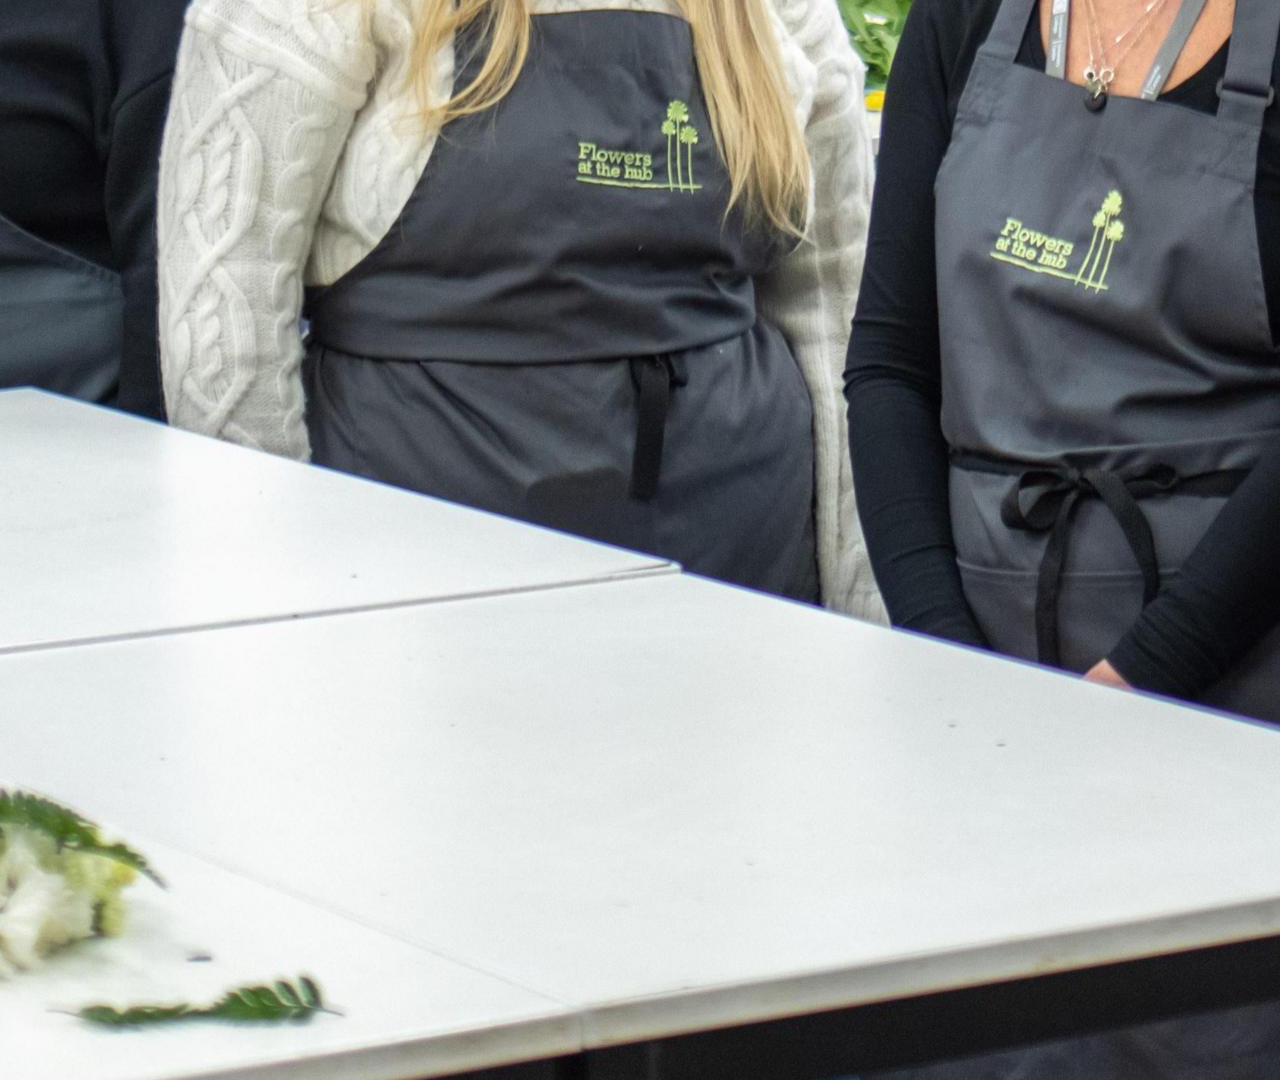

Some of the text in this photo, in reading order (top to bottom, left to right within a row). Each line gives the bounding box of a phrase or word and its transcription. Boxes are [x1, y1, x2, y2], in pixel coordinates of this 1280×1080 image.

[578, 141, 652, 167] Flowers
[577, 161, 653, 181] at the hub
[1001, 217, 1074, 256] Flowers
[995, 237, 1067, 269] at the hub
